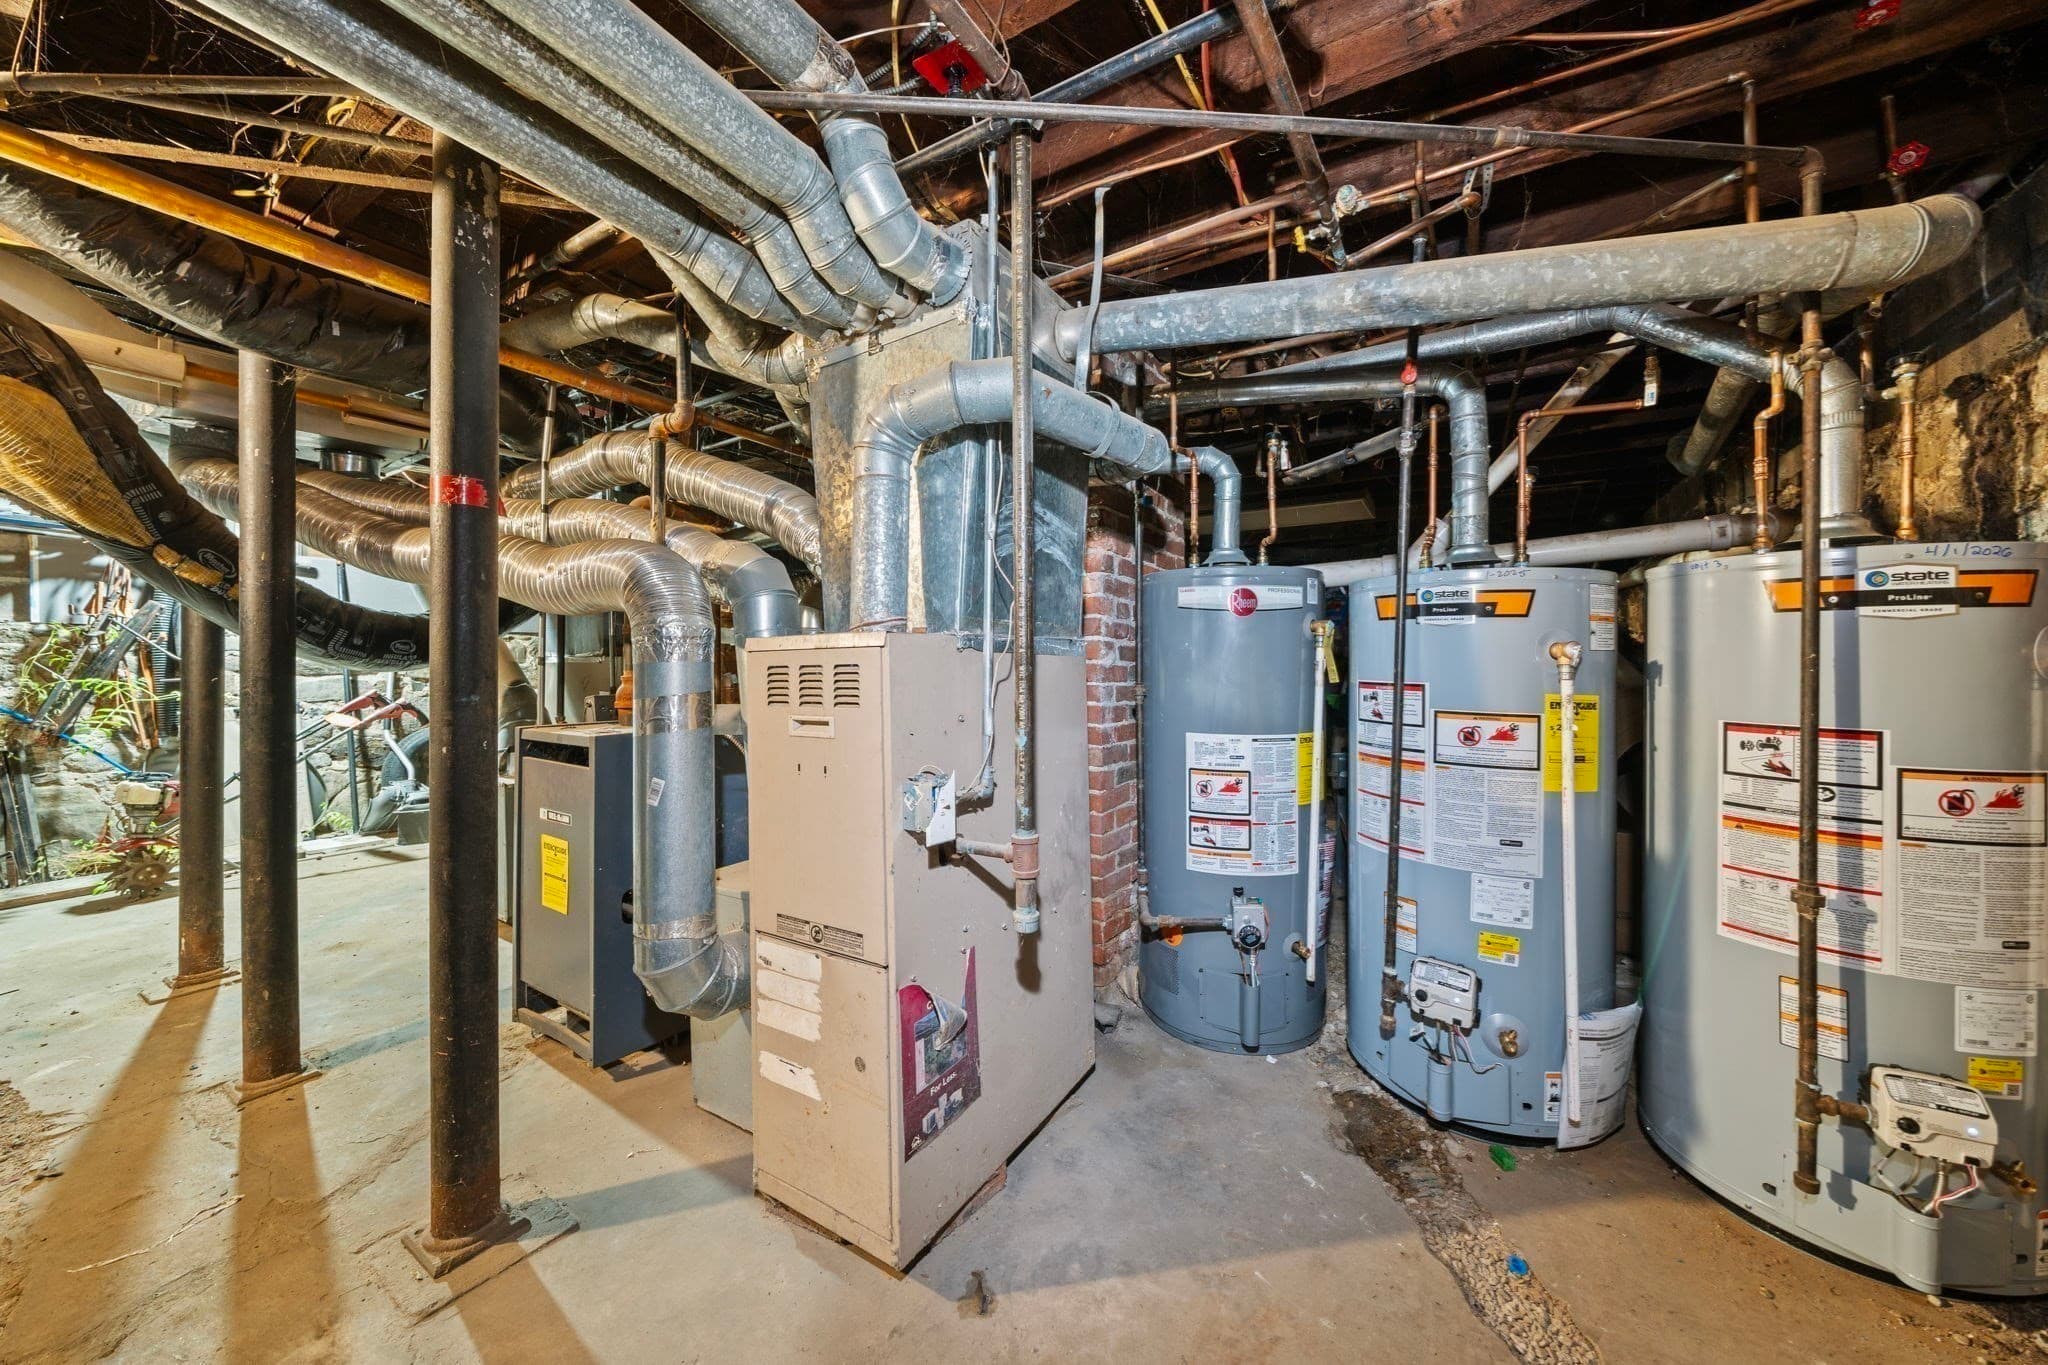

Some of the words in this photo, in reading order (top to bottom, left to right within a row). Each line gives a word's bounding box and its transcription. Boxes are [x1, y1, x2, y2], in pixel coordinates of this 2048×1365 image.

[1891, 570, 1949, 581] state
[1434, 589, 1470, 598] state
[1230, 593, 1257, 613] Rheem
